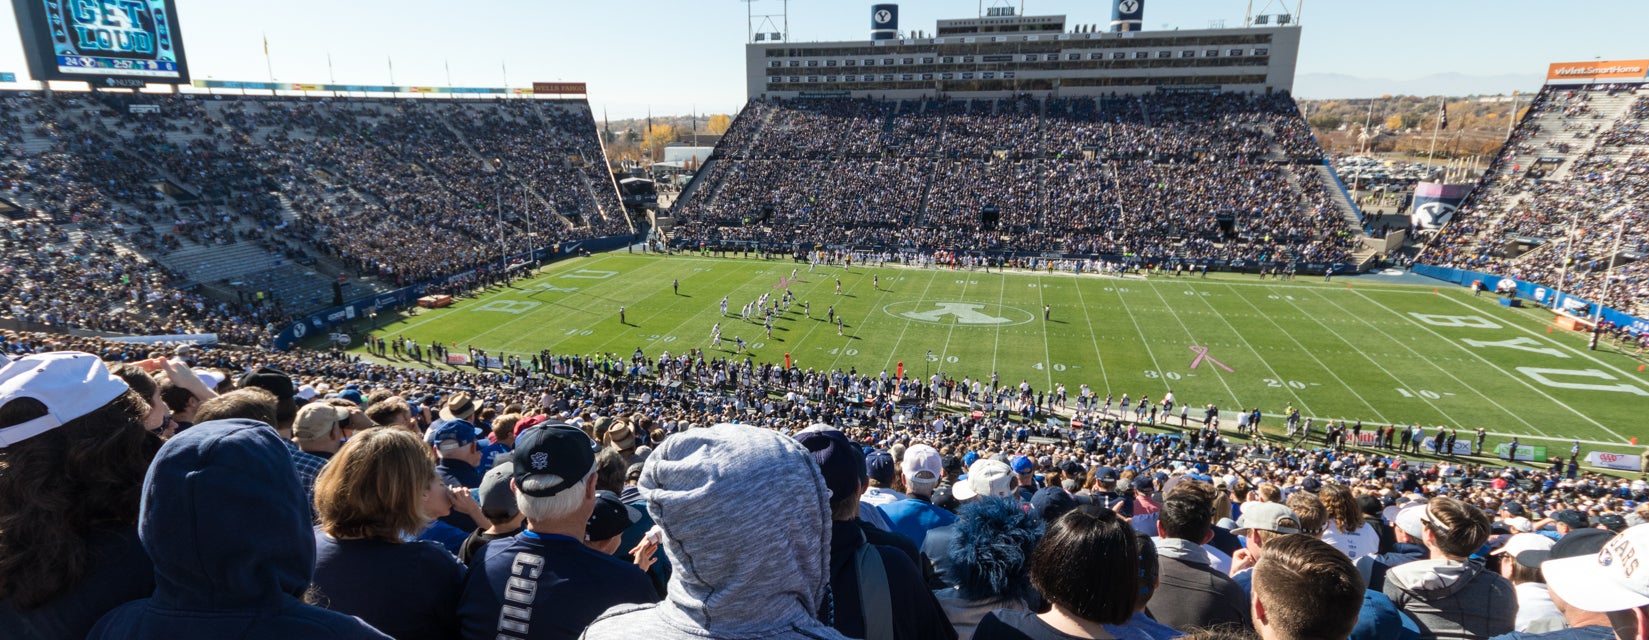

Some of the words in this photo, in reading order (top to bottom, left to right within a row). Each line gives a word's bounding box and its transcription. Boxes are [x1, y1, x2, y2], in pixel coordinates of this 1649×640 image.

[70, 0, 144, 29] GET
[75, 26, 155, 53] LOUD
[65, 56, 78, 66] 24
[113, 60, 133, 69] 2:57
[828, 348, 859, 356] 40
[1408, 312, 1649, 396] BYU
[927, 354, 959, 364] 50
[1031, 362, 1067, 372] 40
[1143, 369, 1182, 381] 30
[1263, 378, 1307, 390] 20
[1394, 387, 1441, 400] 10
[496, 551, 546, 640] COU
